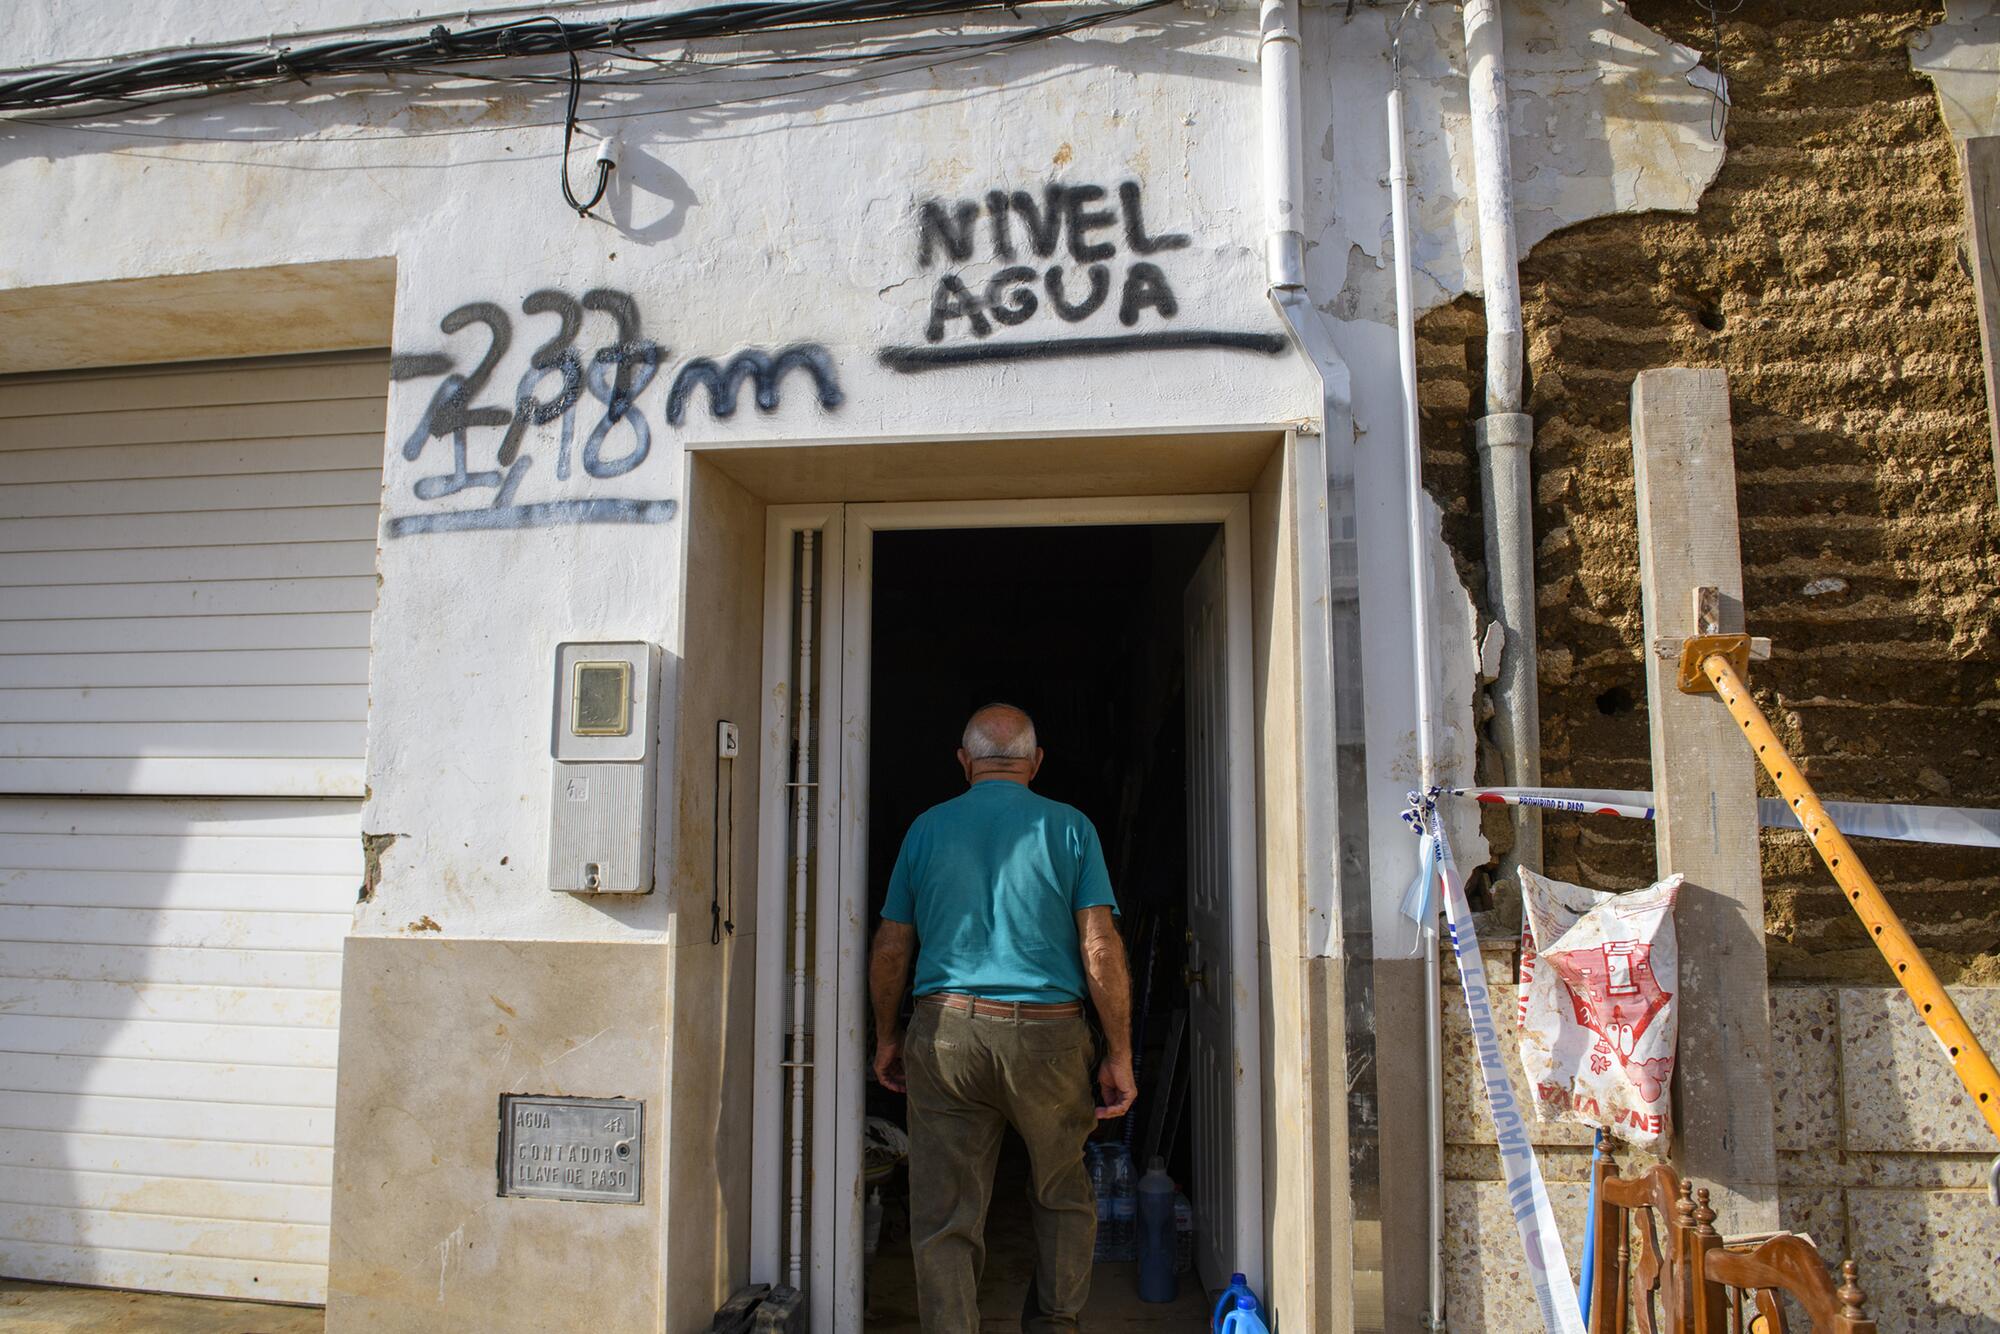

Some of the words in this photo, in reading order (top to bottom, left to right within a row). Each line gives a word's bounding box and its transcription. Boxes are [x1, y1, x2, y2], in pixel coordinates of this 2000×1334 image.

[915, 180, 1191, 269] NIVEL
[925, 261, 1180, 343] AGUA
[515, 1110, 551, 1129] AGUA
[518, 1143, 613, 1164] CONTADOR
[519, 1164, 560, 1183] LLAVE
[564, 1167, 583, 1185] DE
[591, 1168, 627, 1187] PASO
